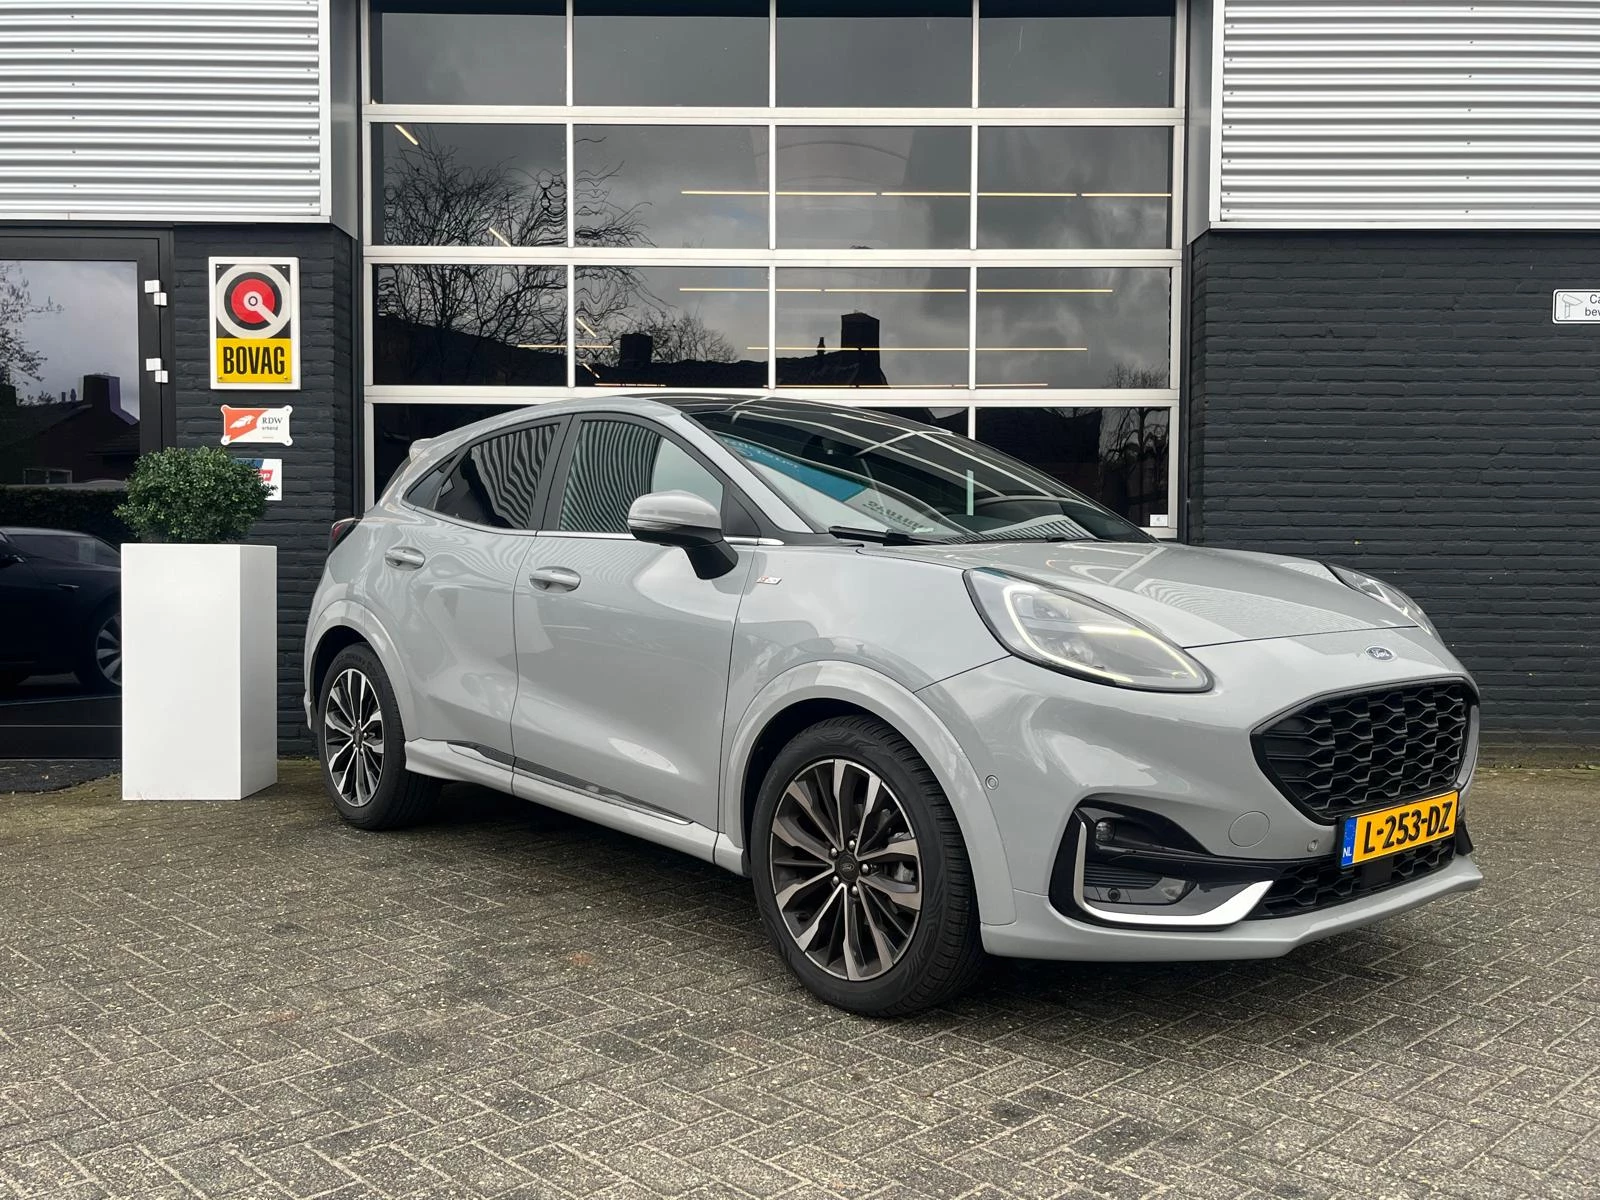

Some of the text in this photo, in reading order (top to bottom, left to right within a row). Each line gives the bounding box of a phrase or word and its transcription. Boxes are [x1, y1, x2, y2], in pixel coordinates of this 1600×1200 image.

[223, 346, 285, 375] BOVAG
[262, 416, 283, 424] RDW
[1363, 801, 1453, 854] L-253-DZ
[1342, 847, 1352, 858] NL
